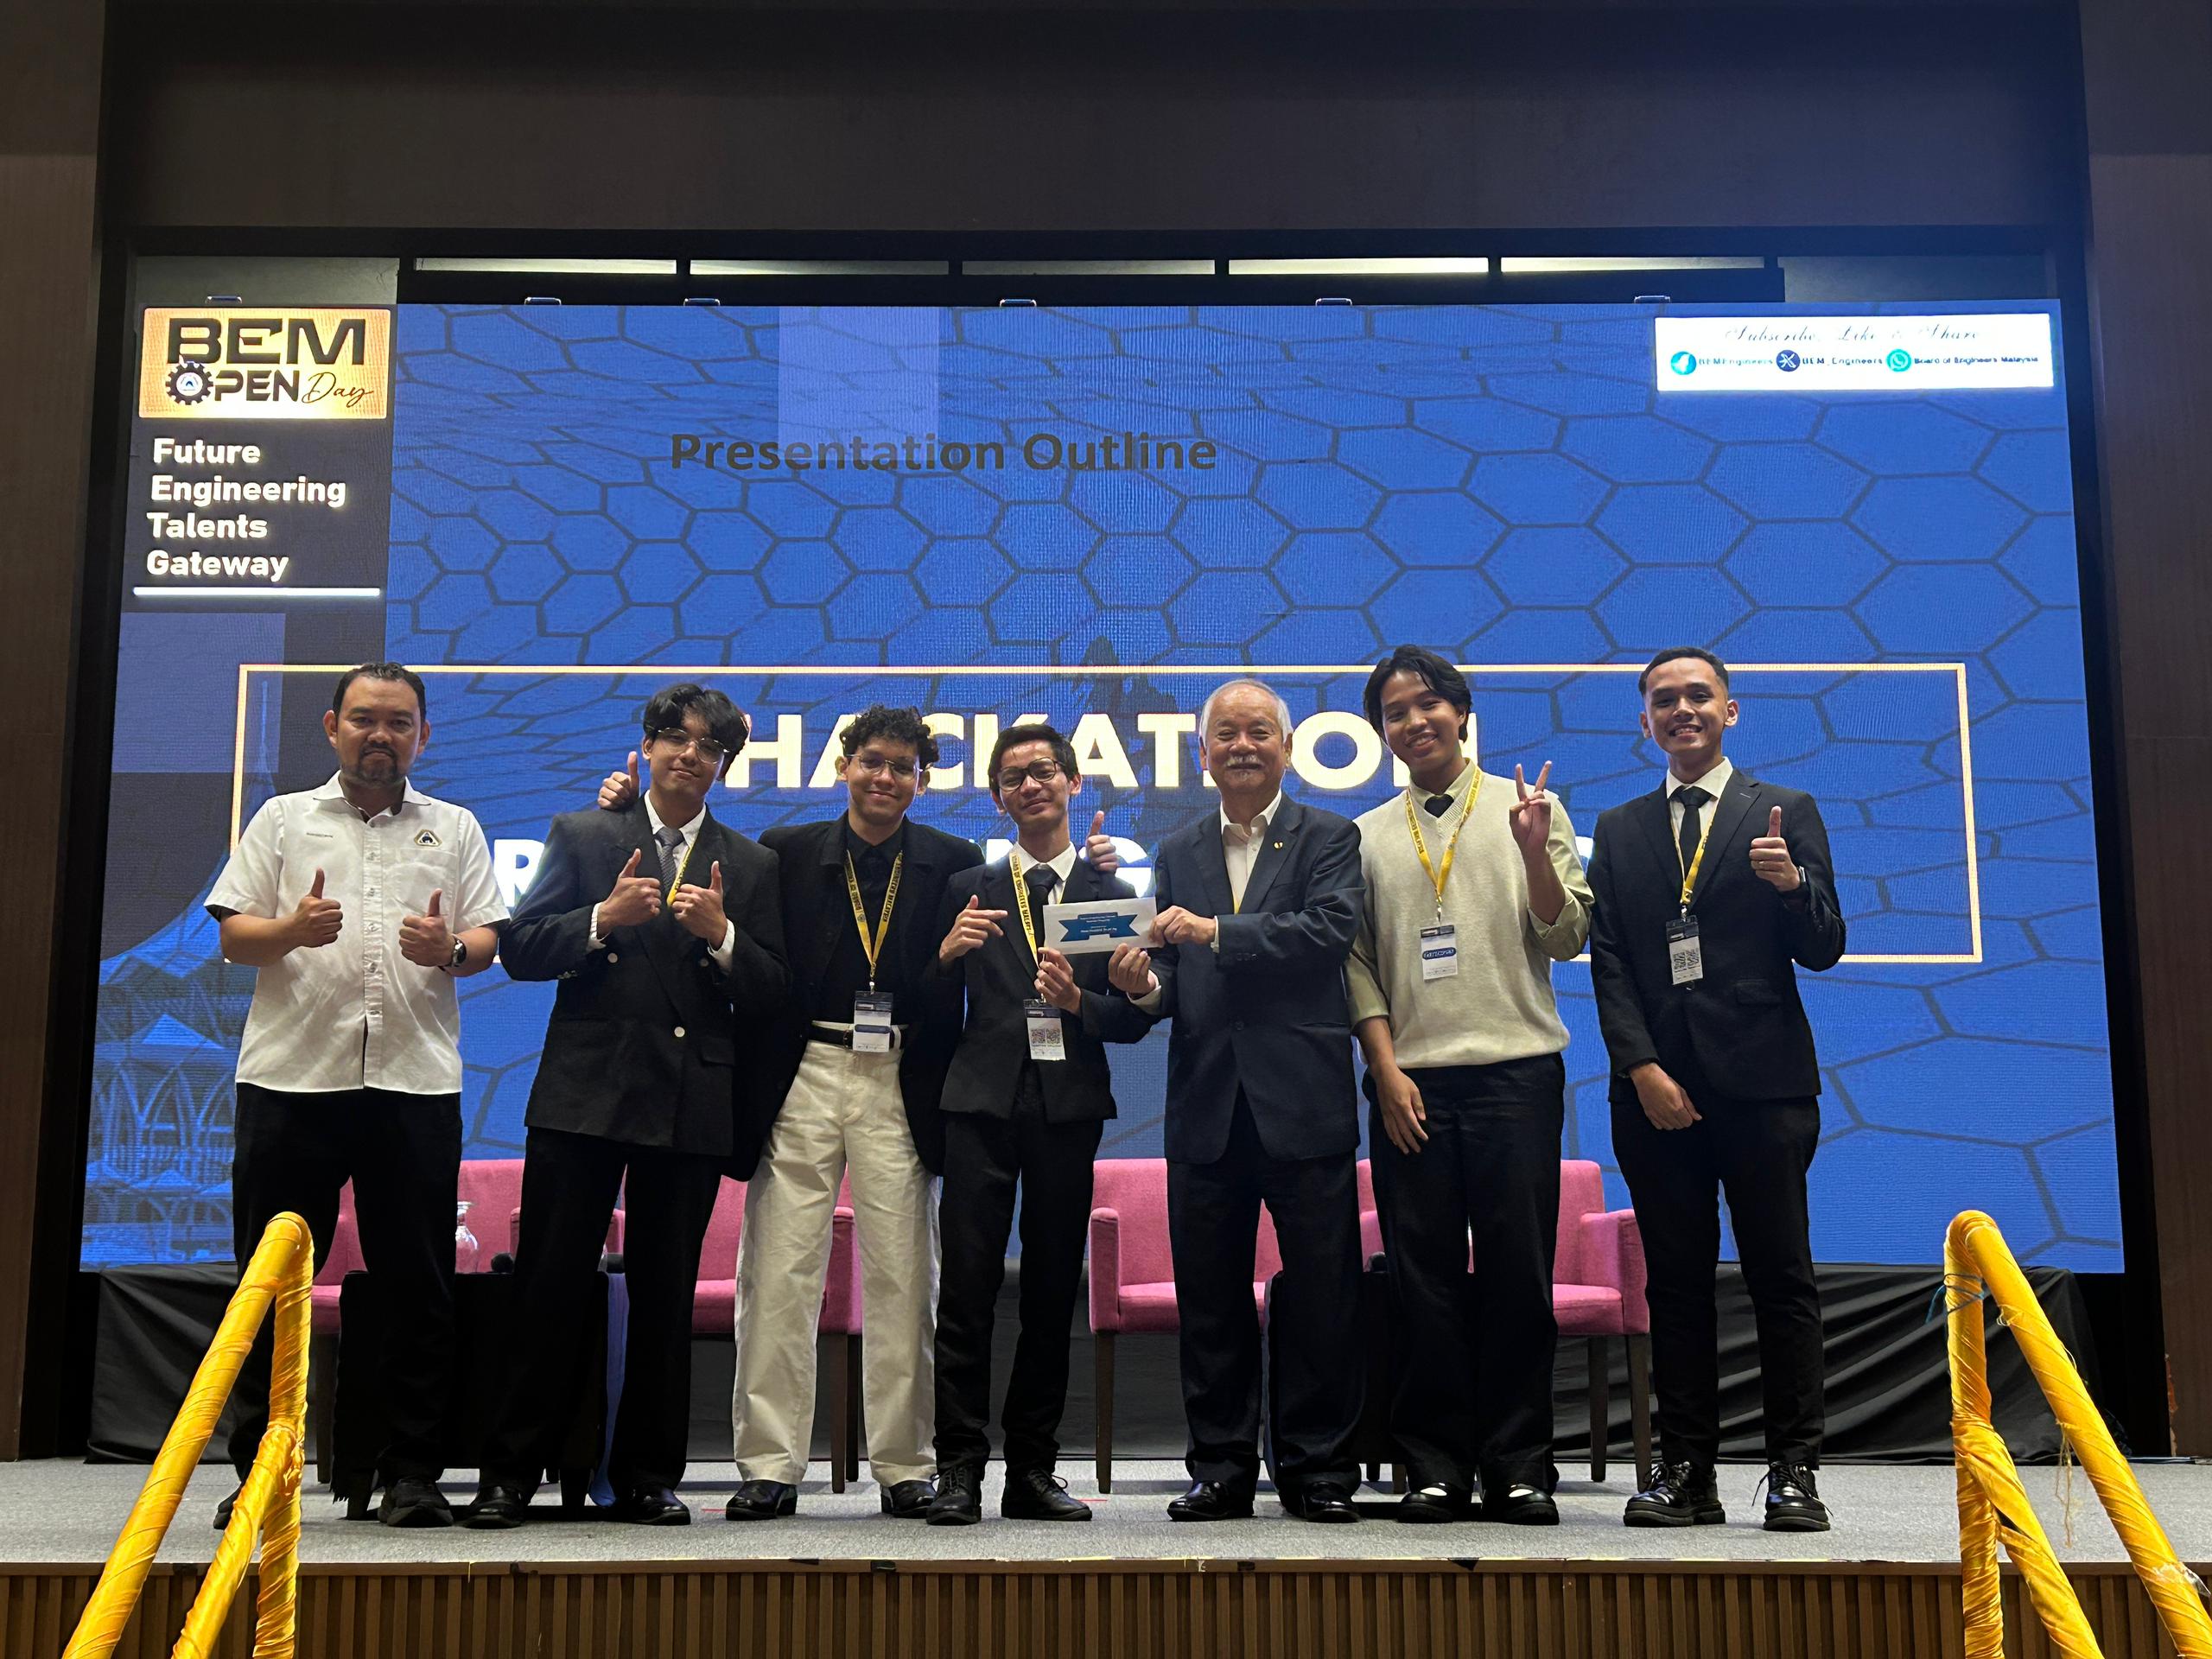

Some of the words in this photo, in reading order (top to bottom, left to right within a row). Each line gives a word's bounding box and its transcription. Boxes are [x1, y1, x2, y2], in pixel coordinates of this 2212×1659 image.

[168, 318, 365, 365] BEM
[1955, 357, 1998, 365] Engineers
[2000, 356, 2038, 365] Malaysia
[302, 372, 374, 408] Day
[153, 438, 261, 463] Future
[671, 432, 1004, 471] Presentation
[1023, 432, 1217, 471] Outline
[151, 475, 346, 507] Engineering
[147, 512, 268, 538] Talents
[147, 550, 289, 582] Gateway
